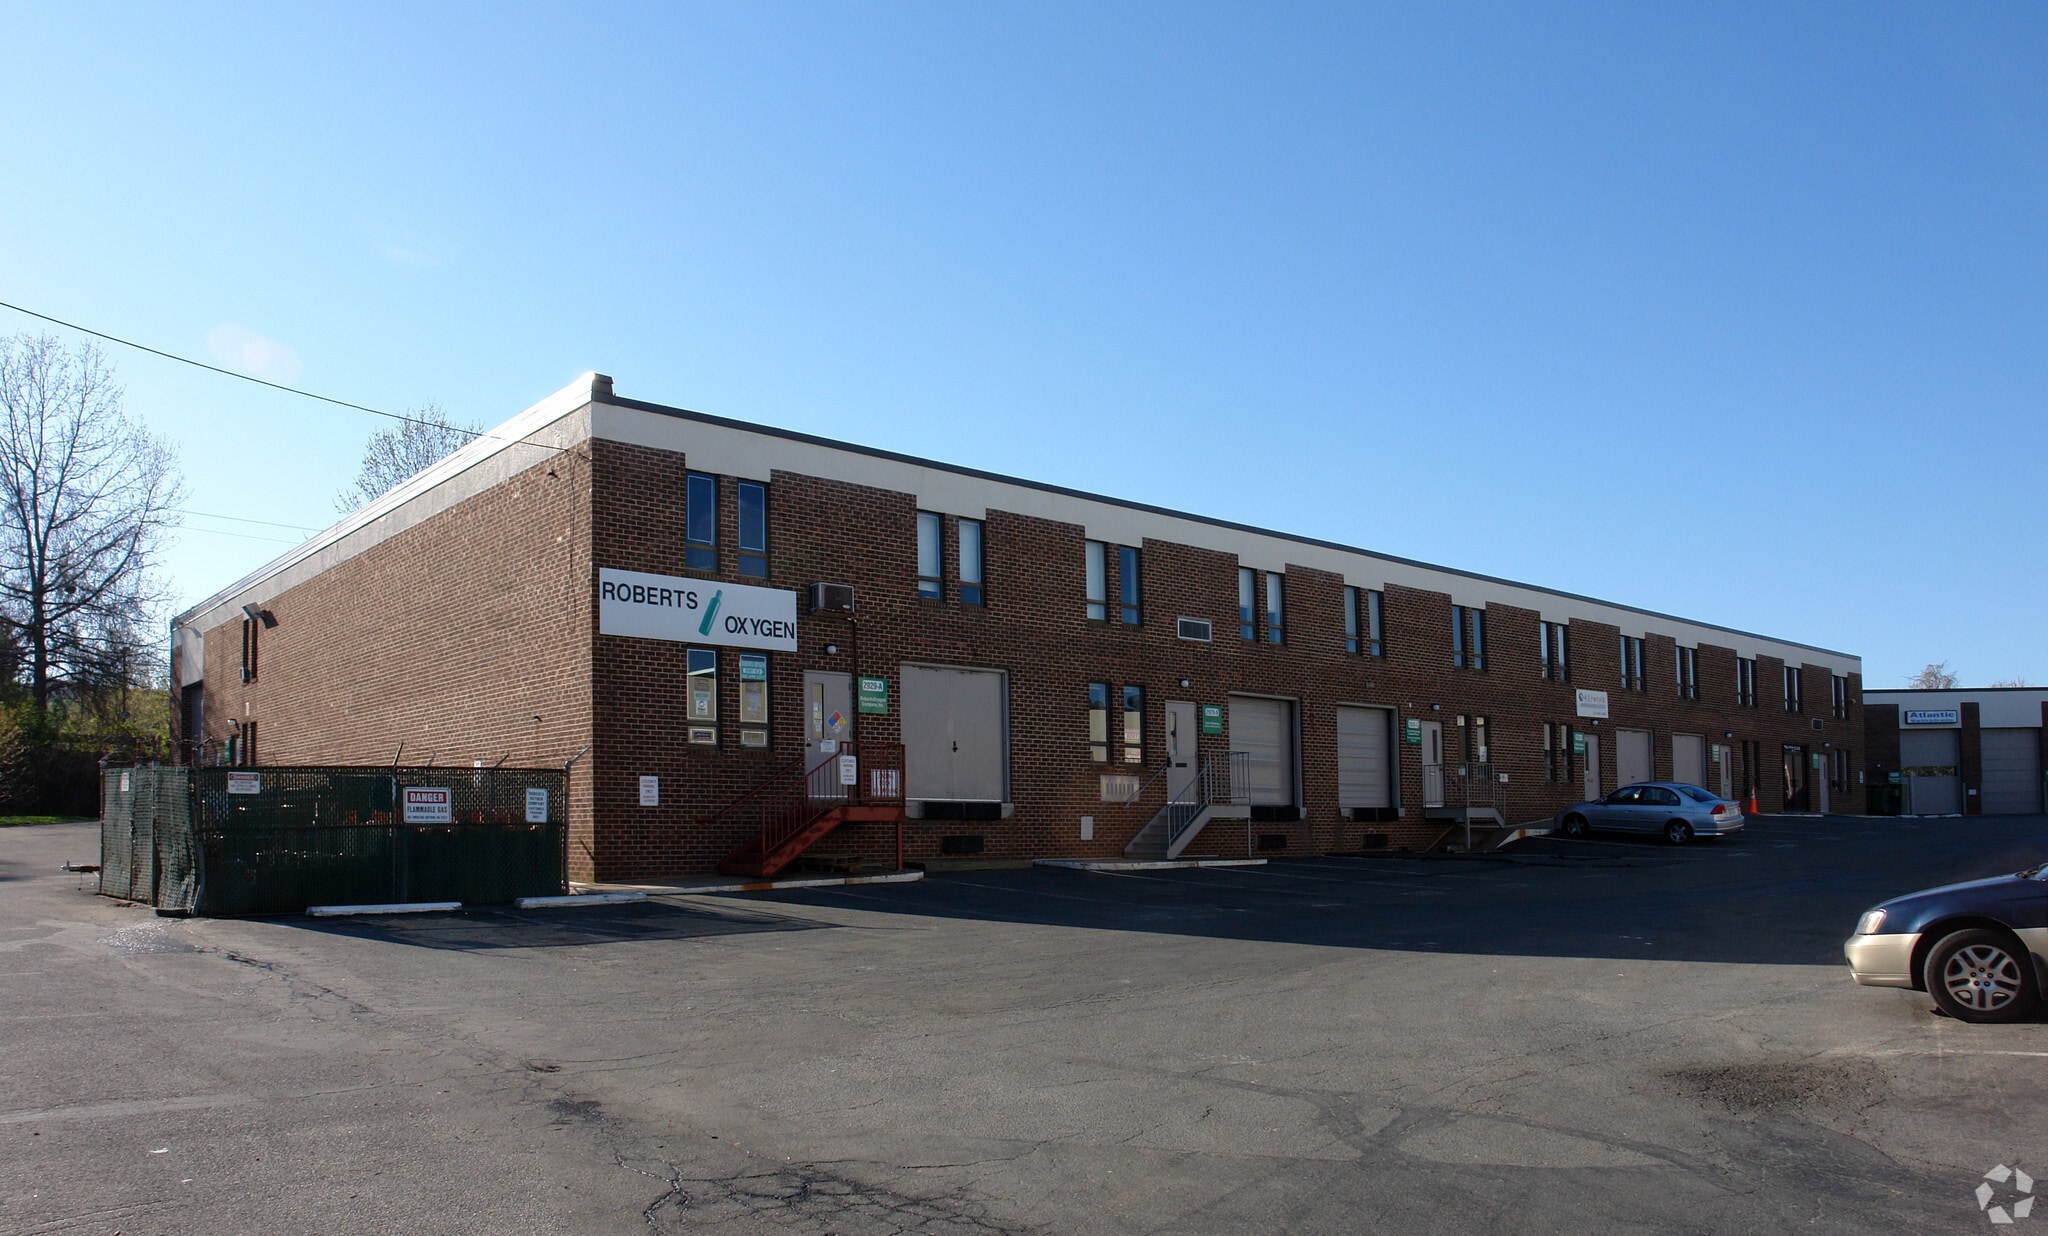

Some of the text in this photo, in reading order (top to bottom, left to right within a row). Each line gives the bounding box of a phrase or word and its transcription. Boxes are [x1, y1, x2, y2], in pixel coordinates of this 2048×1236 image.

[602, 581, 698, 610] ROBERTS
[725, 615, 795, 639] OXYGEN
[863, 682, 883, 690] 2929-A
[410, 792, 444, 802] DANGER
